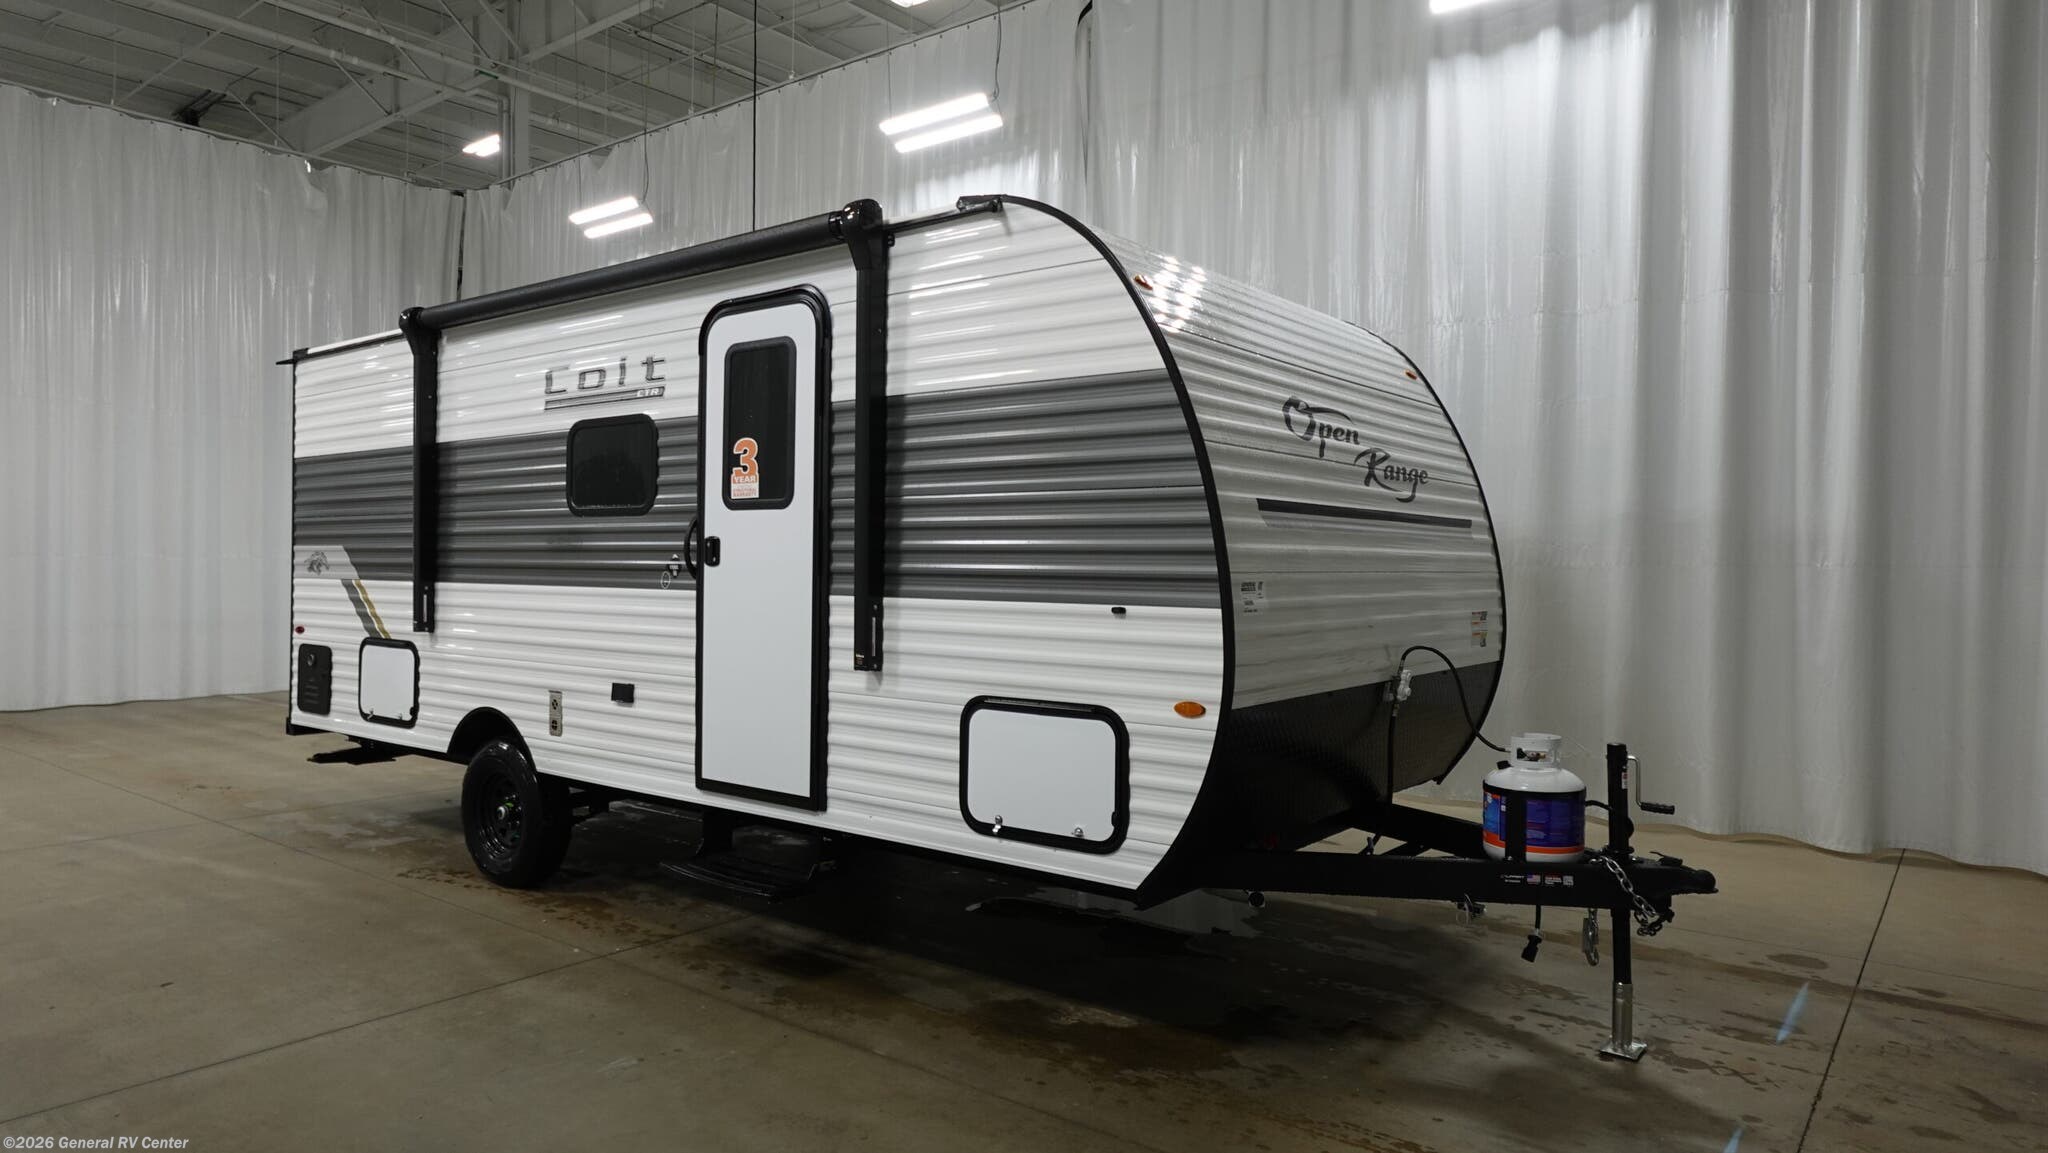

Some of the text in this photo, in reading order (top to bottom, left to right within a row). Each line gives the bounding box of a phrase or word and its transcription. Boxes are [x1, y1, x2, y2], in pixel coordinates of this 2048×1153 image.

[1282, 396, 1361, 458] Open
[732, 437, 759, 476] 3
[734, 475, 756, 483] YEAR
[1354, 447, 1429, 503] Range
